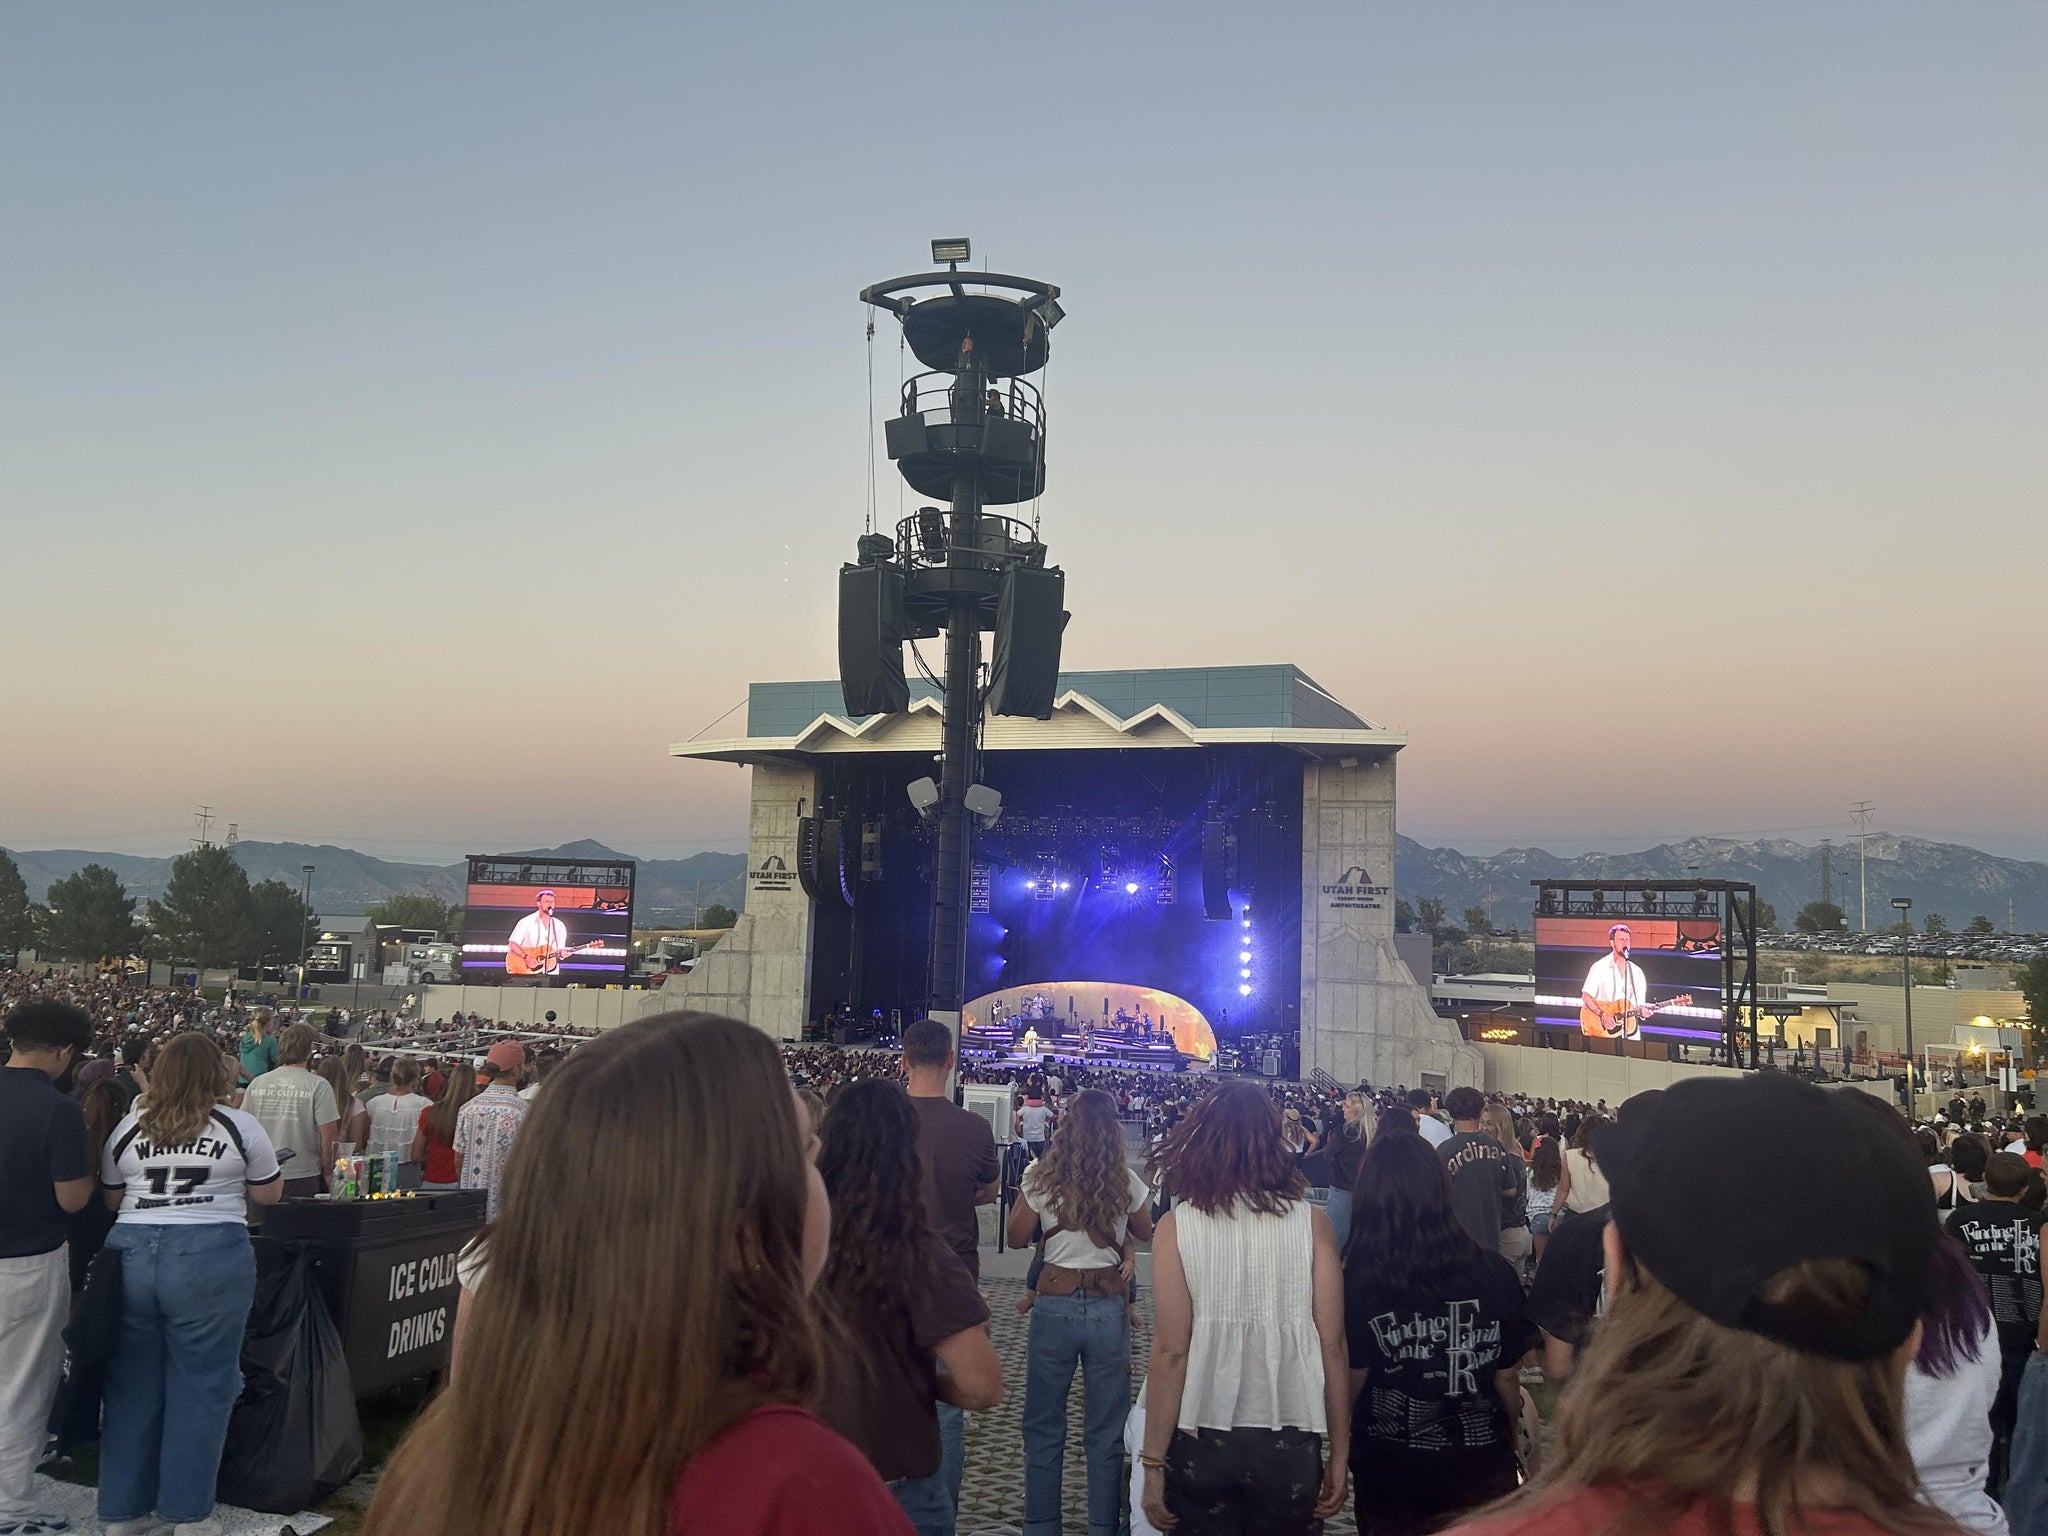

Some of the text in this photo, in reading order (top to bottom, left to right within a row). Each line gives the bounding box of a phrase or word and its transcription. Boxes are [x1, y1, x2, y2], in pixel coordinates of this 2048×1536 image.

[1322, 886, 1389, 896] UTAH FIRST
[144, 1165, 212, 1197] 17
[1960, 1220, 2015, 1243] Finding
[1974, 1242, 1990, 1253] on
[388, 1252, 457, 1302] ICE COLD
[387, 1306, 447, 1359] DRINKS
[1367, 1311, 1450, 1358] Finding
